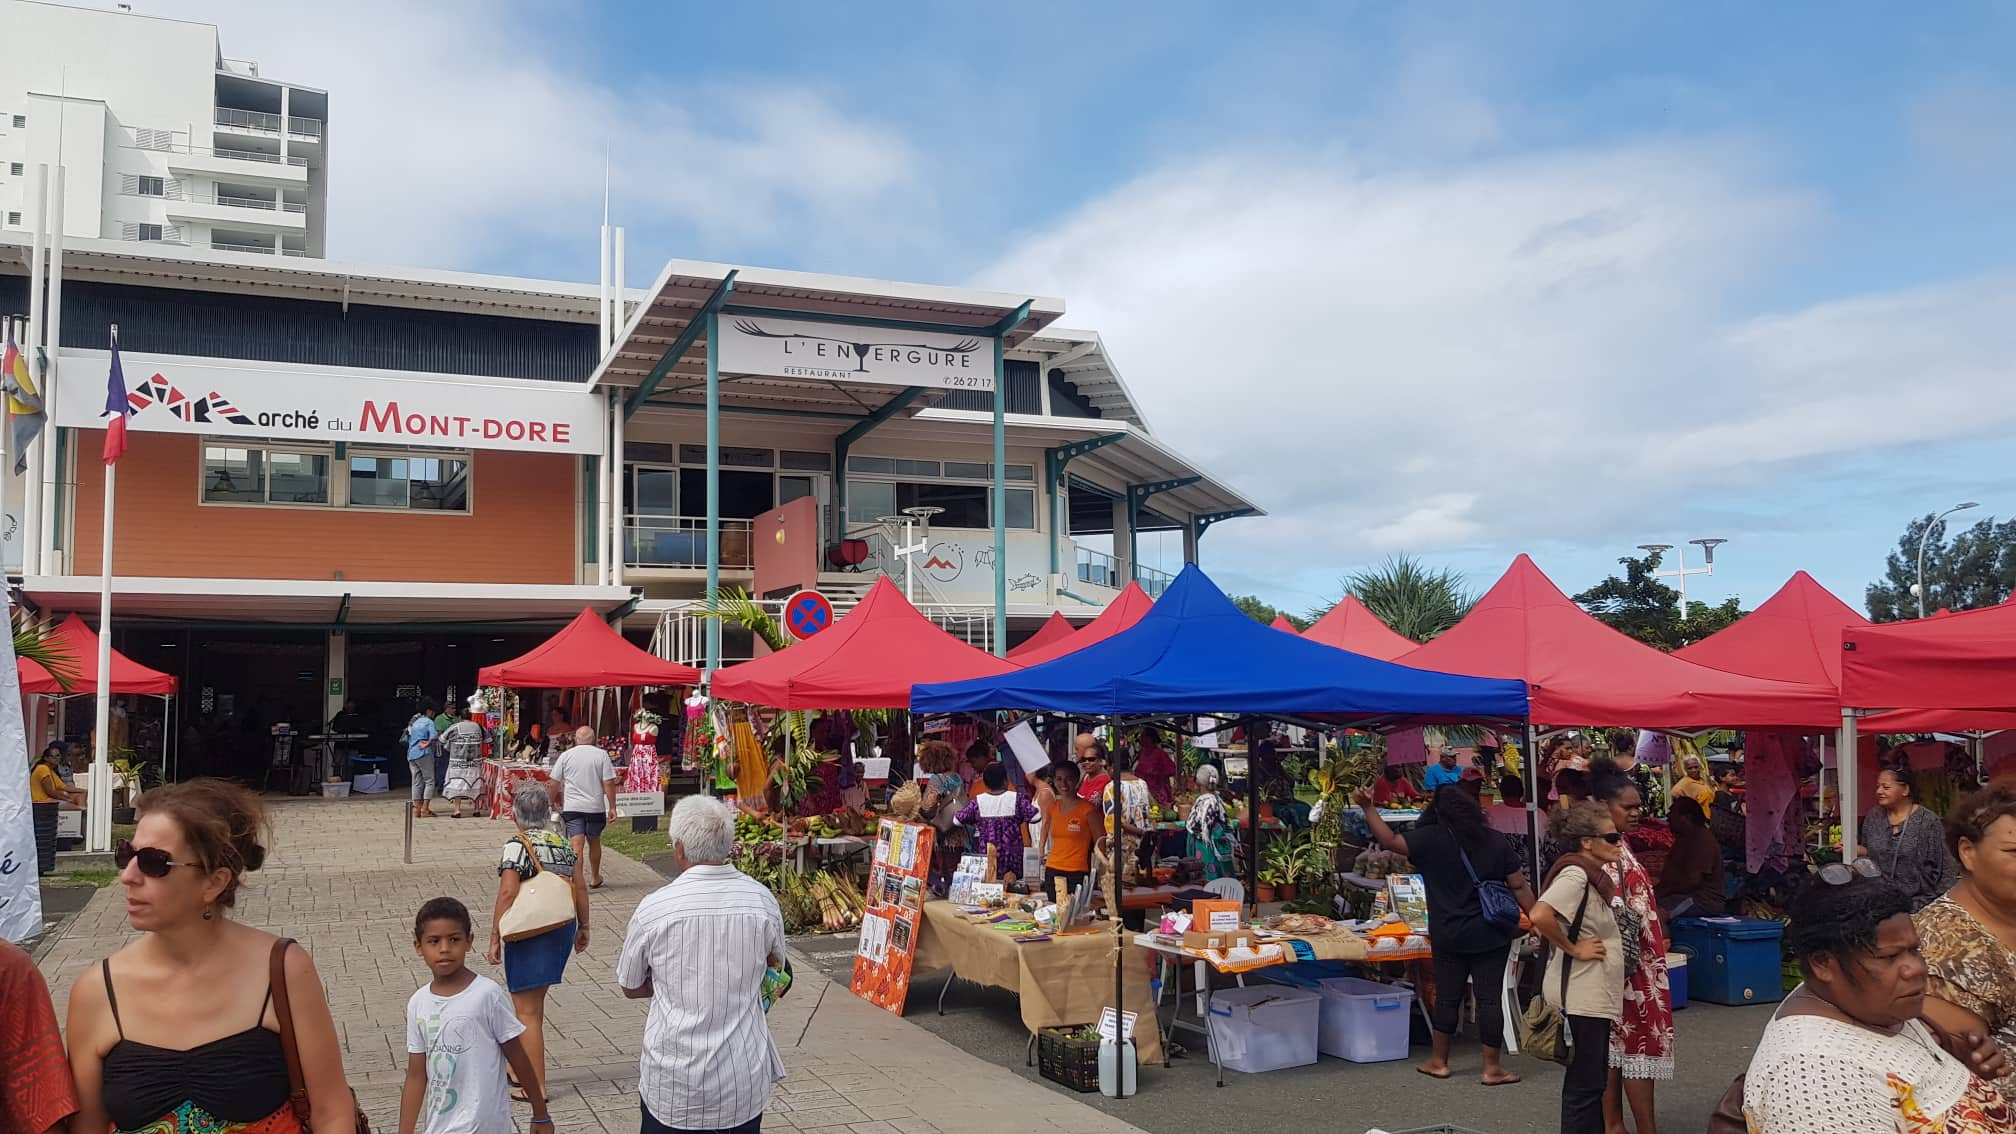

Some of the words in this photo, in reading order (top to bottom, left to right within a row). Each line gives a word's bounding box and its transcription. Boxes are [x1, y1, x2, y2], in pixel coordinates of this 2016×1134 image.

[784, 367, 852, 378] RESTAURANT
[953, 376, 965, 386] 26
[967, 377, 978, 387] 27
[982, 378, 992, 388] 17
[327, 417, 353, 432] du
[359, 399, 571, 444] MONT-DORE
